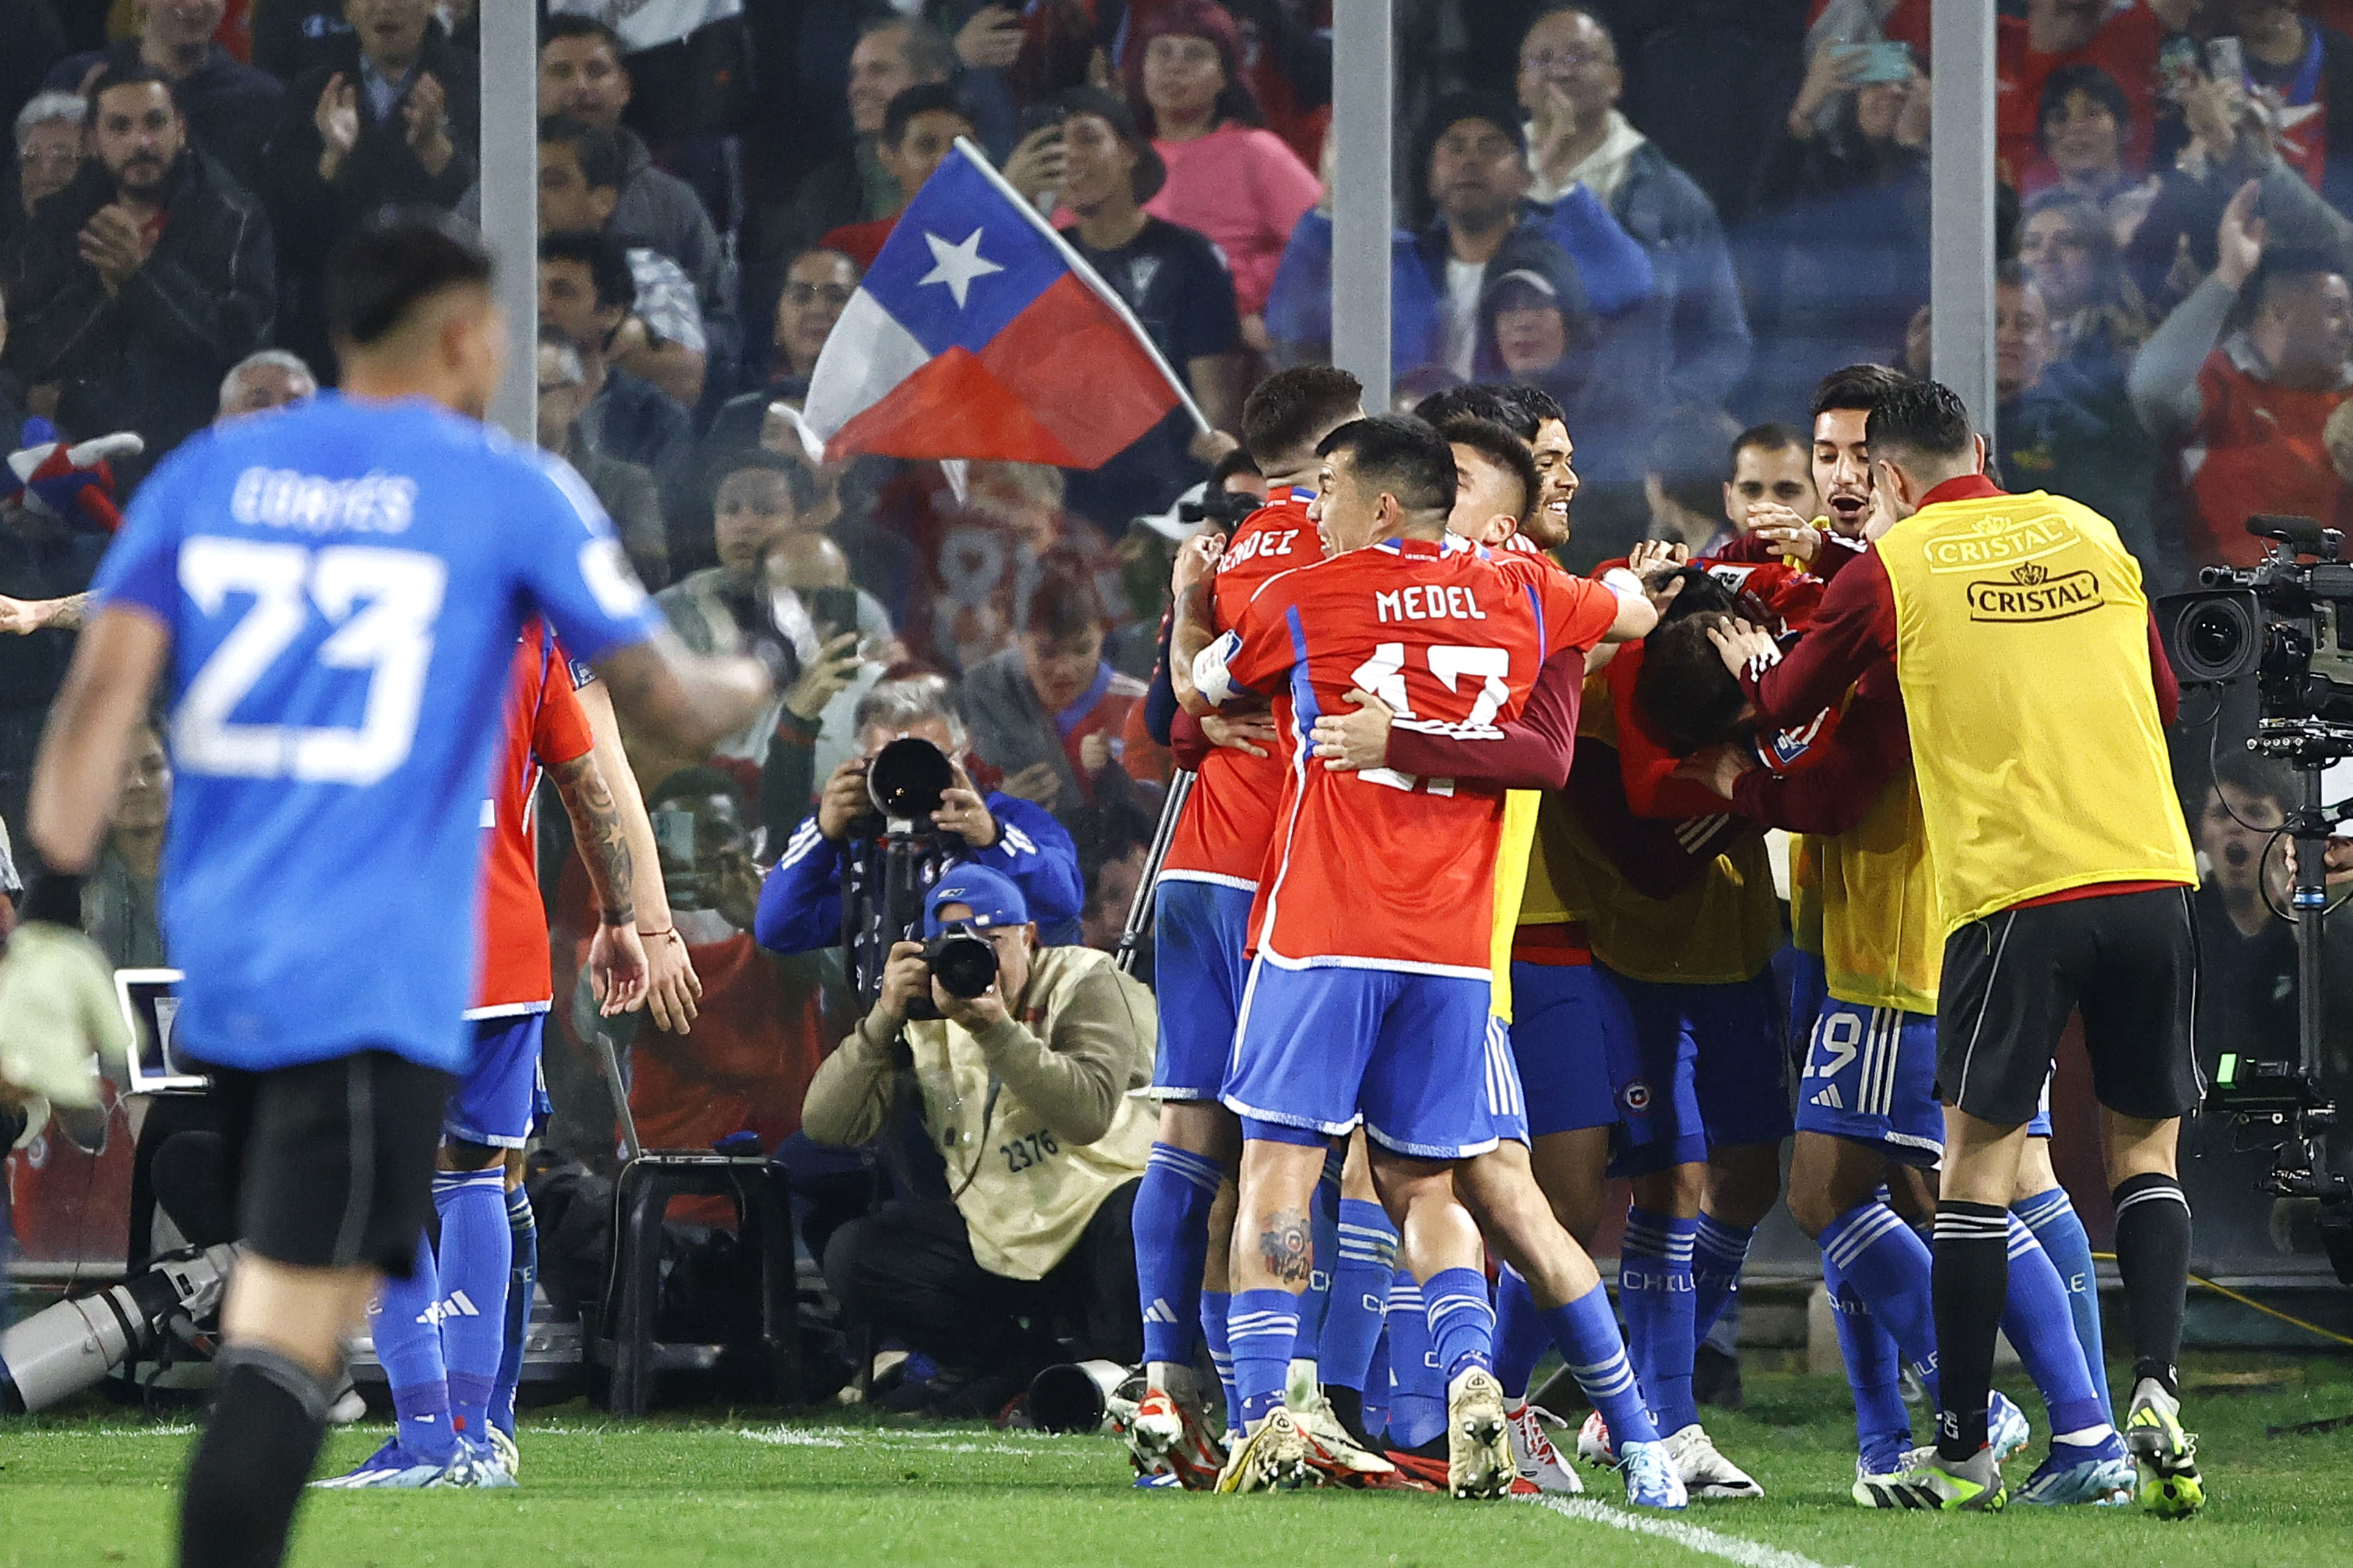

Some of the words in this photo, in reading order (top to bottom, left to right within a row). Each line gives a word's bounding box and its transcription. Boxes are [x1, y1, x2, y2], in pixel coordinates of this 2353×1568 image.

[1937, 523, 2064, 564] CRISTAL
[1375, 585, 1487, 623] MEDEL
[1979, 582, 2091, 614] CRISTAL
[171, 535, 448, 787] 23
[1350, 642, 1510, 798] 17
[1802, 1012, 1863, 1078] 19
[1000, 1128, 1058, 1173] 2376
